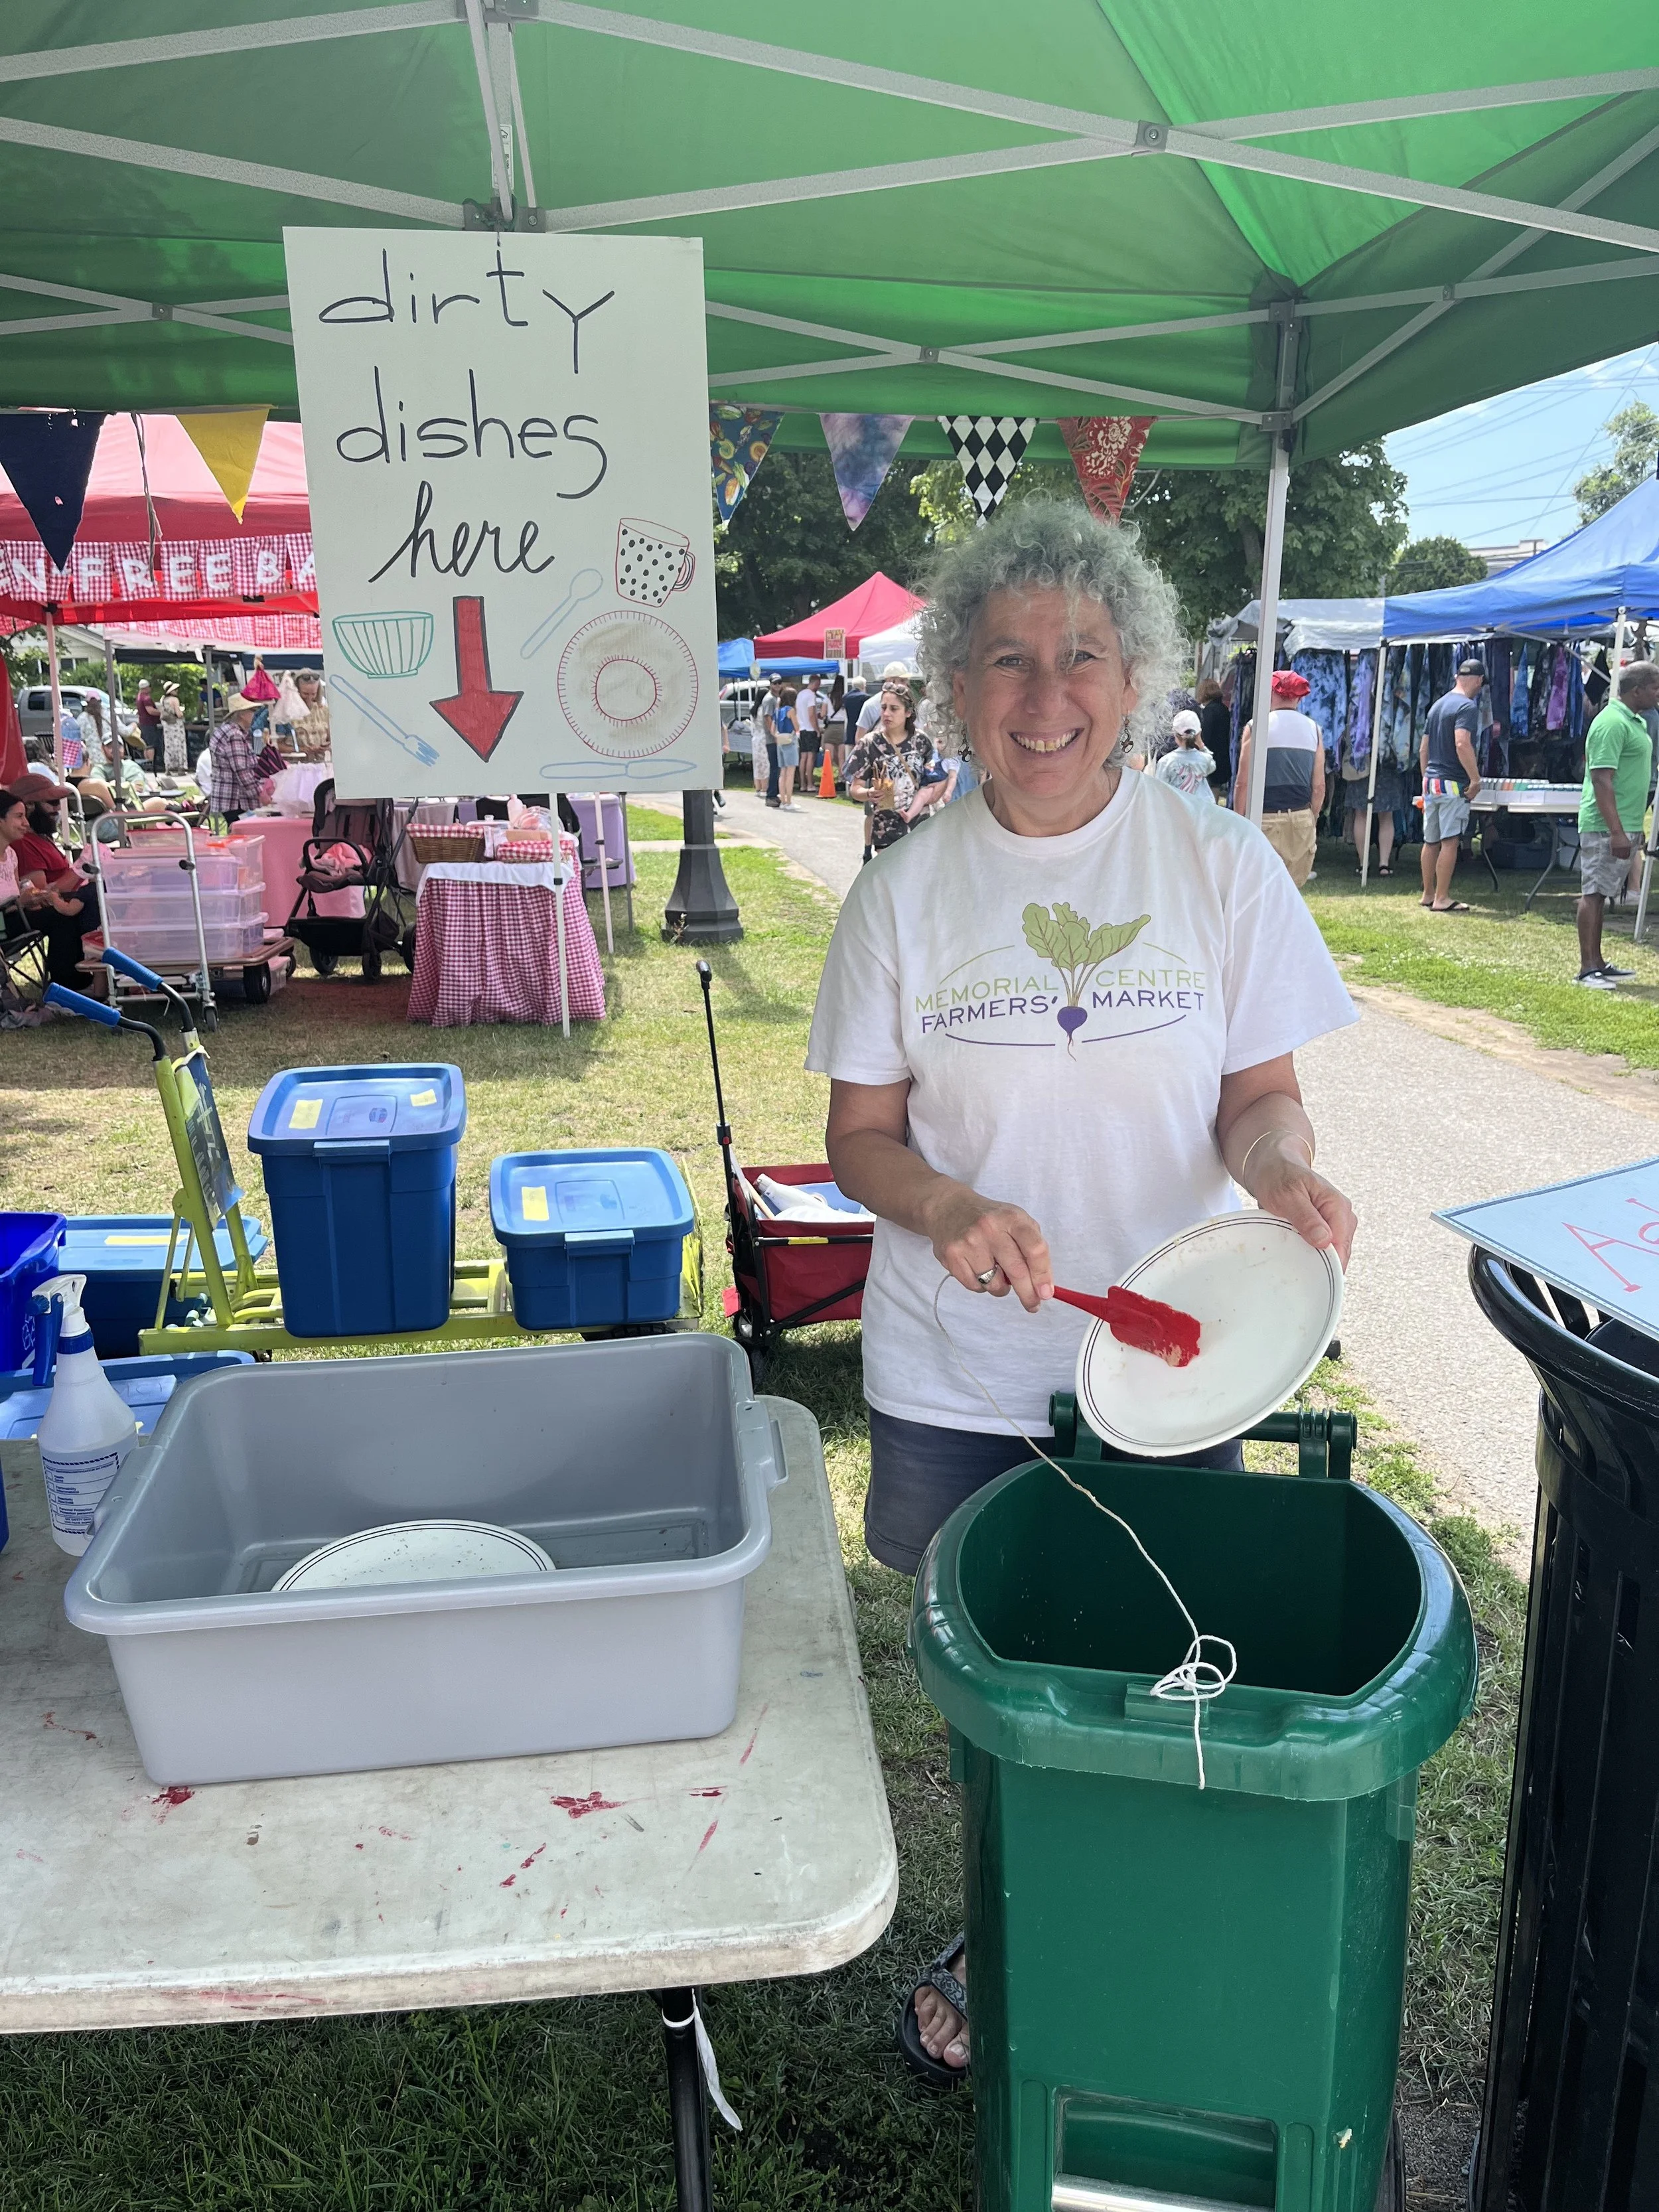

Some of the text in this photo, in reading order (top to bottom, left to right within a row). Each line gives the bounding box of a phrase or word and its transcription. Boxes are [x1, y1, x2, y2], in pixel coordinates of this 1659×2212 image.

[318, 248, 615, 374] dirty
[336, 366, 607, 499] dishes
[368, 480, 555, 583] here
[916, 969, 1206, 1013] MEMORIAL CENTRE
[922, 990, 1204, 1033] FARMERS' MARKET
